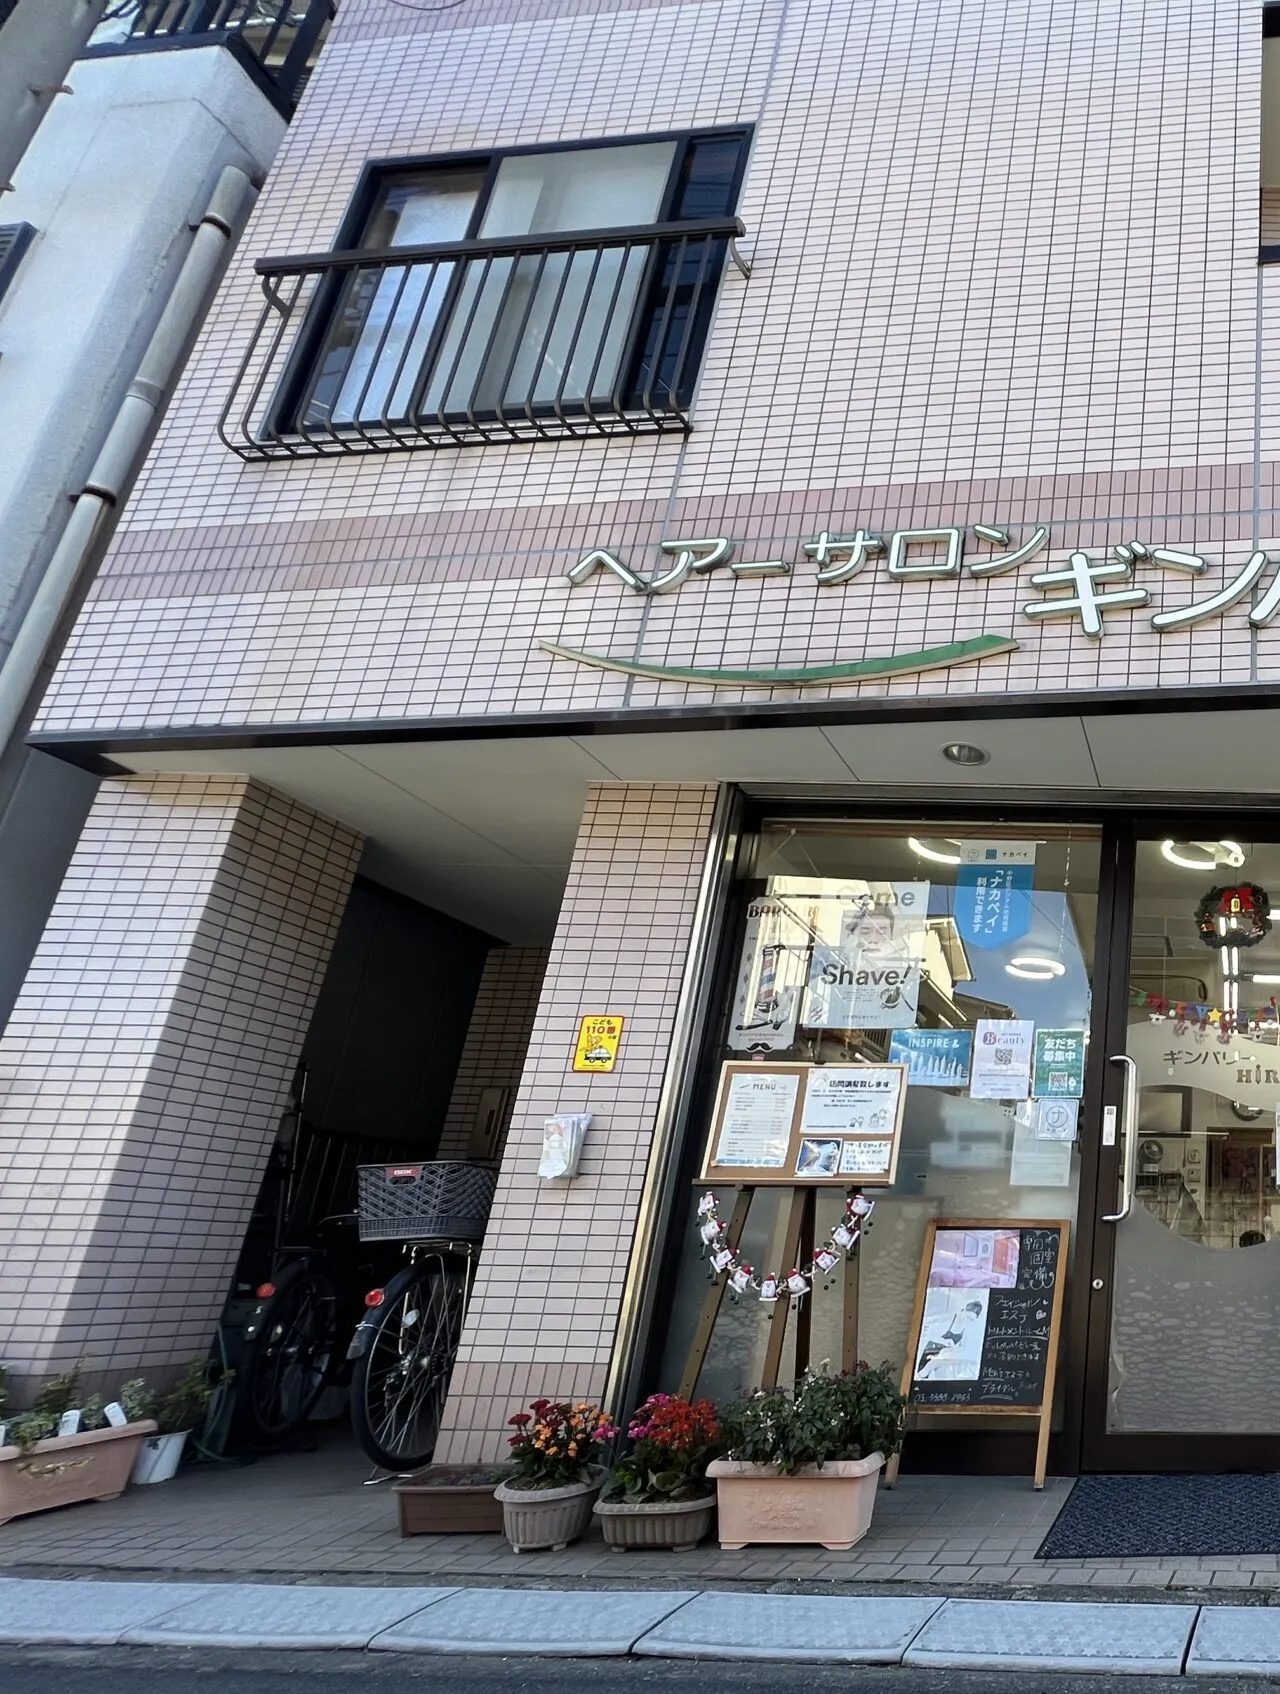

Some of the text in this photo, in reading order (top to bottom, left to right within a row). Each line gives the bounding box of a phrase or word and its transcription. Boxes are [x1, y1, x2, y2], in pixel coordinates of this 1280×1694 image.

[567, 523, 1048, 596] ヘアーサロン
[972, 876, 988, 933] 利用できます
[984, 869, 1004, 934] 「ナカペイ」
[820, 962, 912, 986] Shave!
[908, 1038, 960, 1049] INSPIRE &
[1044, 1038, 1077, 1050] 友だち
[752, 1083, 777, 1091] MENU
